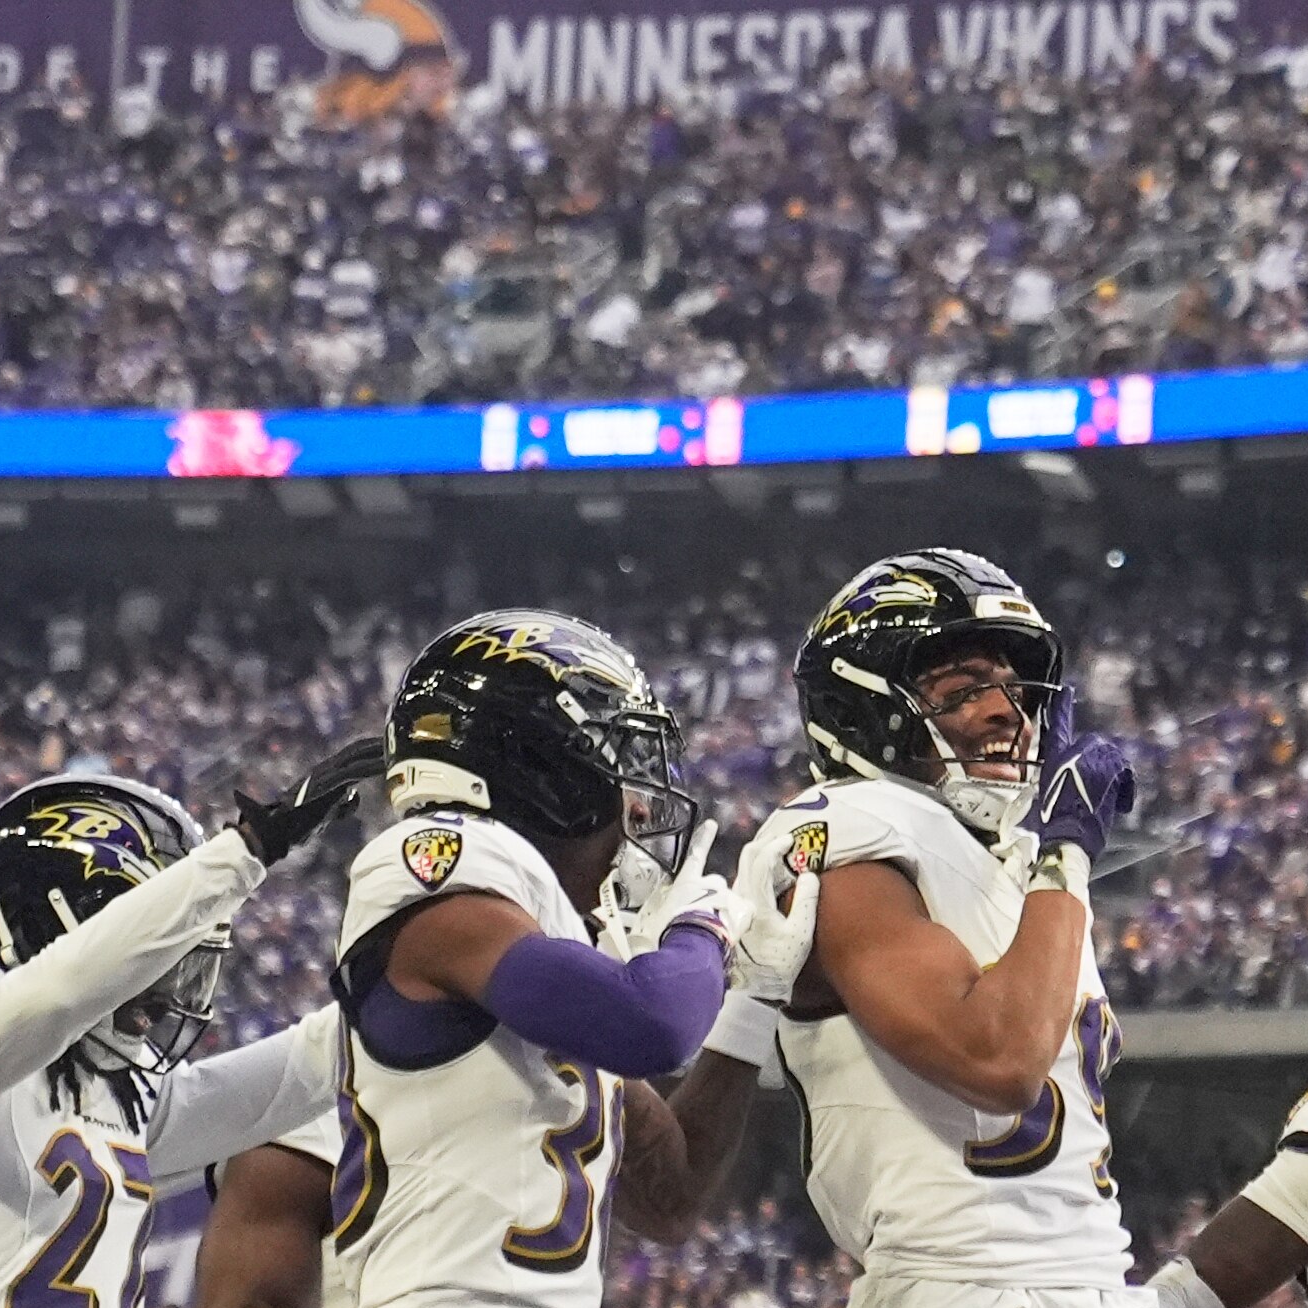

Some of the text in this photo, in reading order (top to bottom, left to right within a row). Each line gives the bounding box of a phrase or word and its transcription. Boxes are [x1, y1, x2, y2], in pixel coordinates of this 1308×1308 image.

[139, 46, 281, 96] THE
[489, 0, 1239, 112] MINNESOTA VIKINGS
